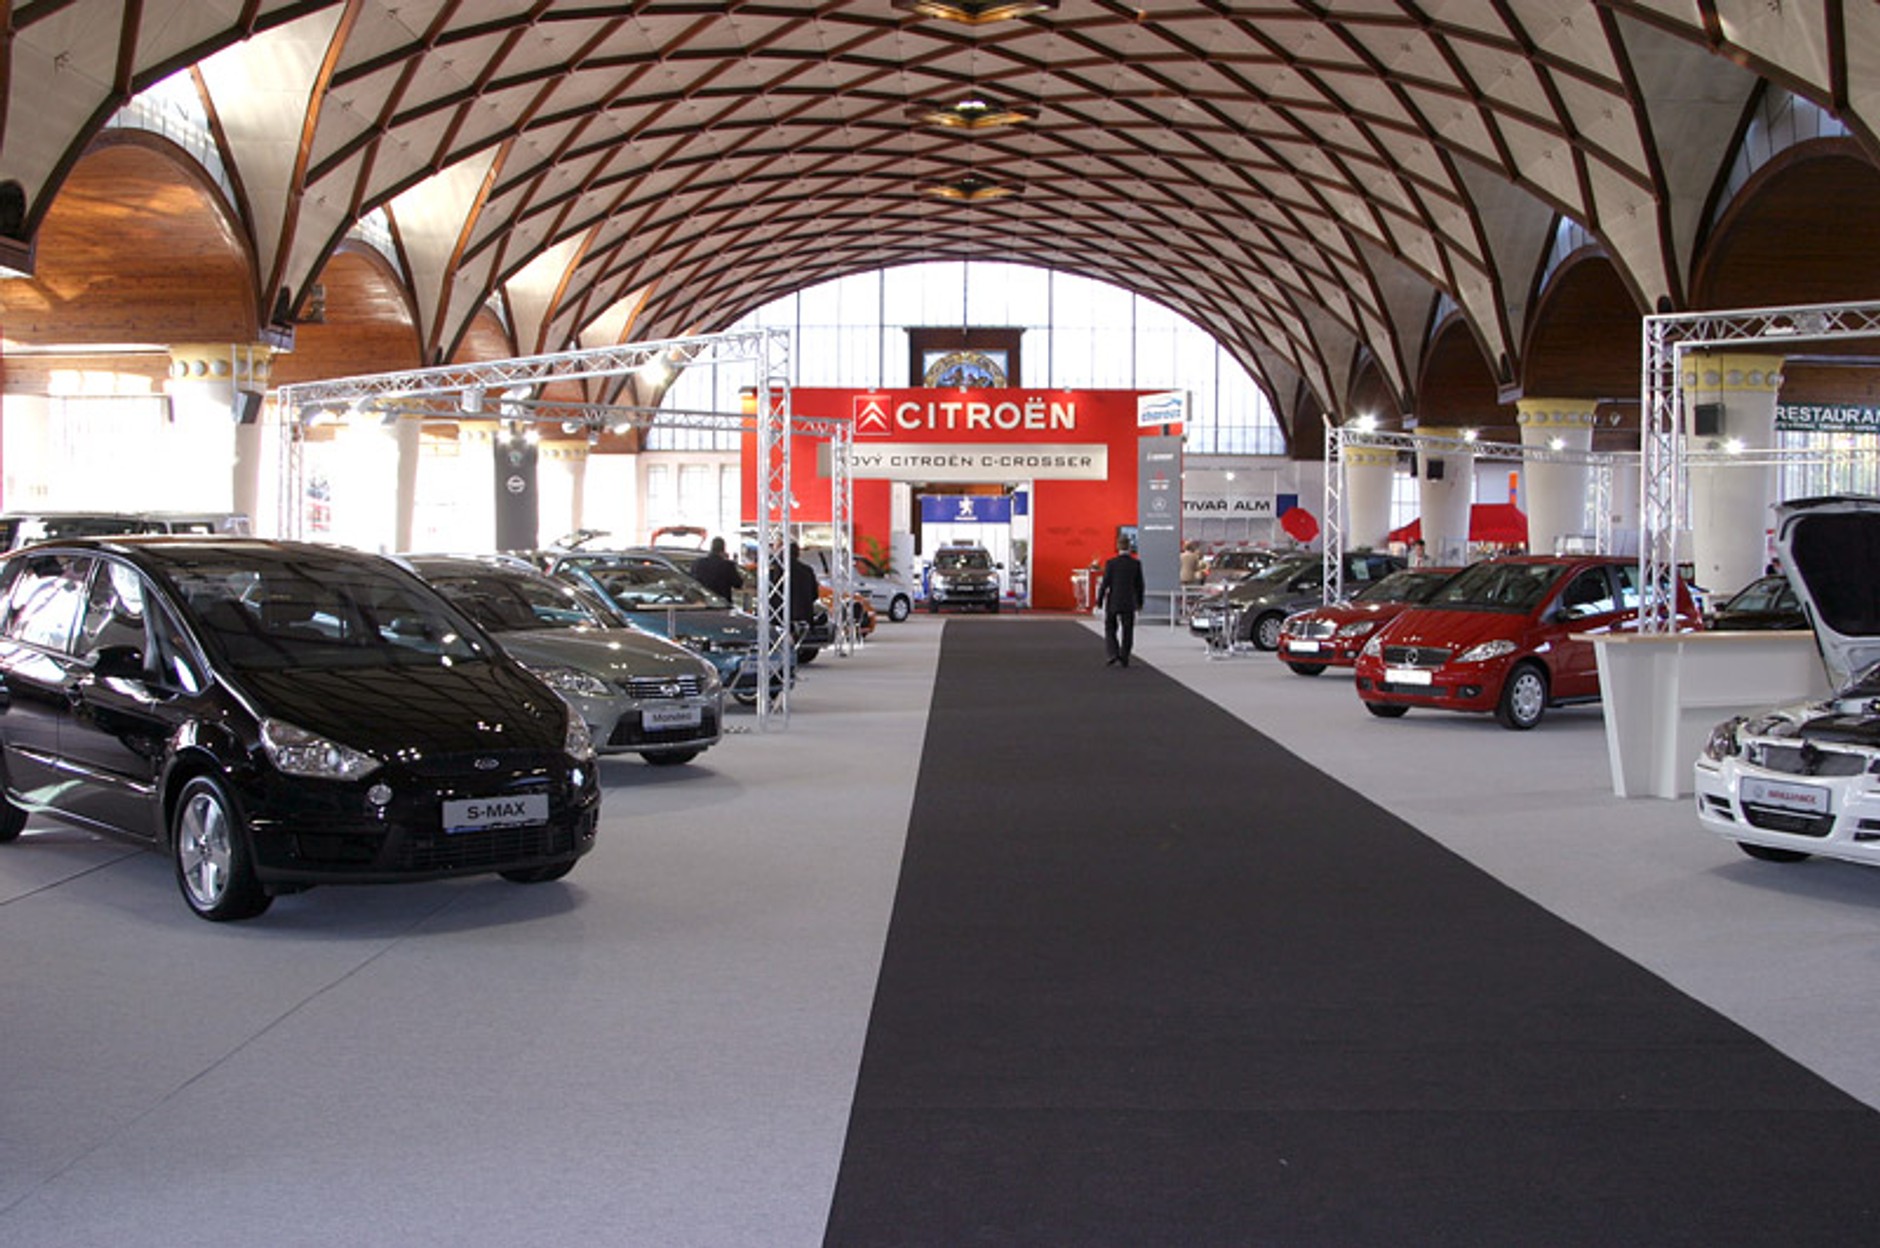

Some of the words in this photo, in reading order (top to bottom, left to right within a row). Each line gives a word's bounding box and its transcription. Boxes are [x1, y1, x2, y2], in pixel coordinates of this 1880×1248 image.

[895, 396, 1075, 429] CITROËN
[890, 453, 973, 467] CITROËN
[1234, 500, 1271, 512] ALM
[466, 801, 526, 820] S-MAX
